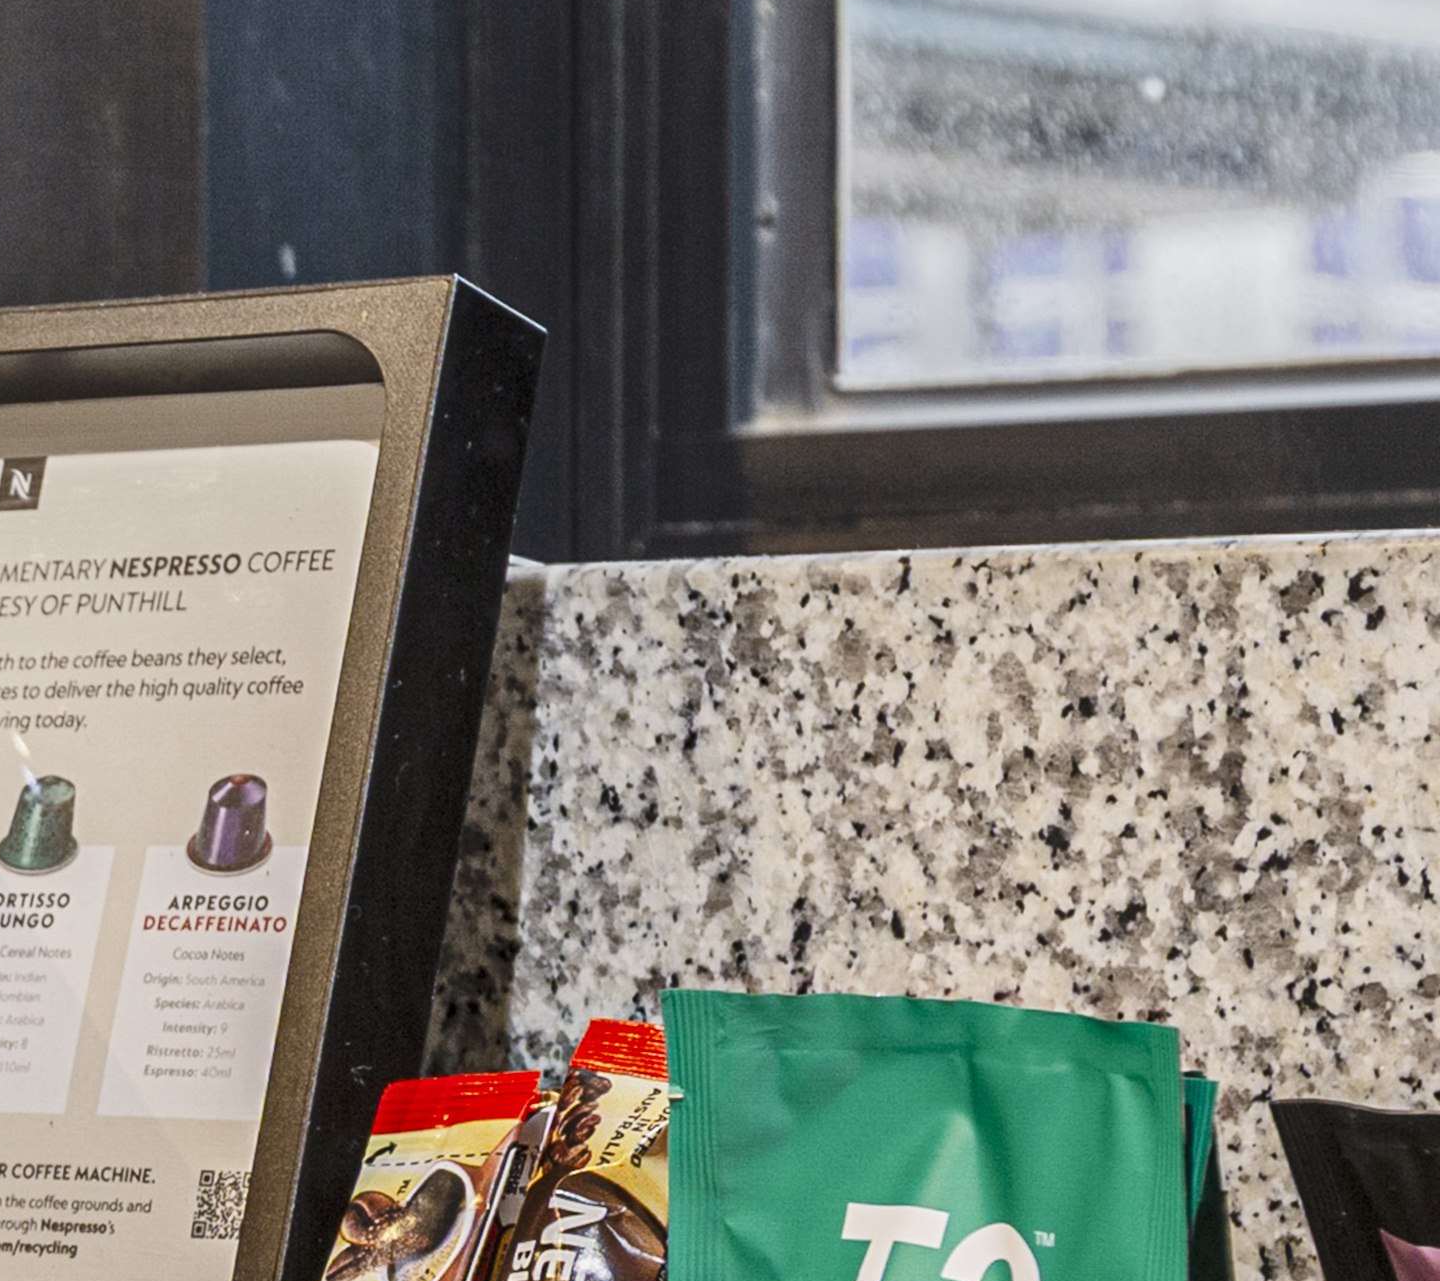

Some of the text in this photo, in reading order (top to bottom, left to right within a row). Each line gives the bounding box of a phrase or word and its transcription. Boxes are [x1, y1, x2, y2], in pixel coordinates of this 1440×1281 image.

[109, 553, 241, 579] NESPRESSO
[247, 549, 335, 573] COFFEE
[41, 594, 72, 615] OF
[76, 590, 187, 613] PUNTHILL
[19, 655, 36, 670] to
[41, 652, 68, 669] the
[73, 650, 126, 668] coffee
[131, 649, 183, 667] beans
[188, 648, 227, 669] they
[230, 646, 286, 666] select,
[22, 684, 40, 699] to
[44, 681, 101, 699] deliver
[106, 680, 135, 698] the
[139, 679, 178, 701] high
[183, 677, 243, 700] quality
[247, 675, 304, 695] coffee
[35, 711, 87, 730] today.
[168, 895, 269, 912] ARPEGGIO
[142, 915, 287, 933] DECAFFEINATO
[0, 945, 37, 958] Cereal
[38, 946, 72, 959] Notes
[173, 947, 245, 961] Cocoa Notes
[144, 972, 183, 988] Origin:
[154, 996, 200, 1011] Species:
[162, 1021, 217, 1036] Intensity:
[146, 1045, 203, 1059] Ristretto:
[144, 1064, 197, 1078] Espresso:
[595, 1087, 662, 1167] AUSTRALIA
[631, 1118, 651, 1132] IN
[630, 1106, 671, 1168] OASTED
[11, 1163, 72, 1180] COFFEE
[74, 1166, 156, 1184] MACHINE.
[5, 1194, 26, 1209] the
[28, 1195, 69, 1210] coffee
[71, 1198, 124, 1214] grounds
[126, 1199, 153, 1214] and
